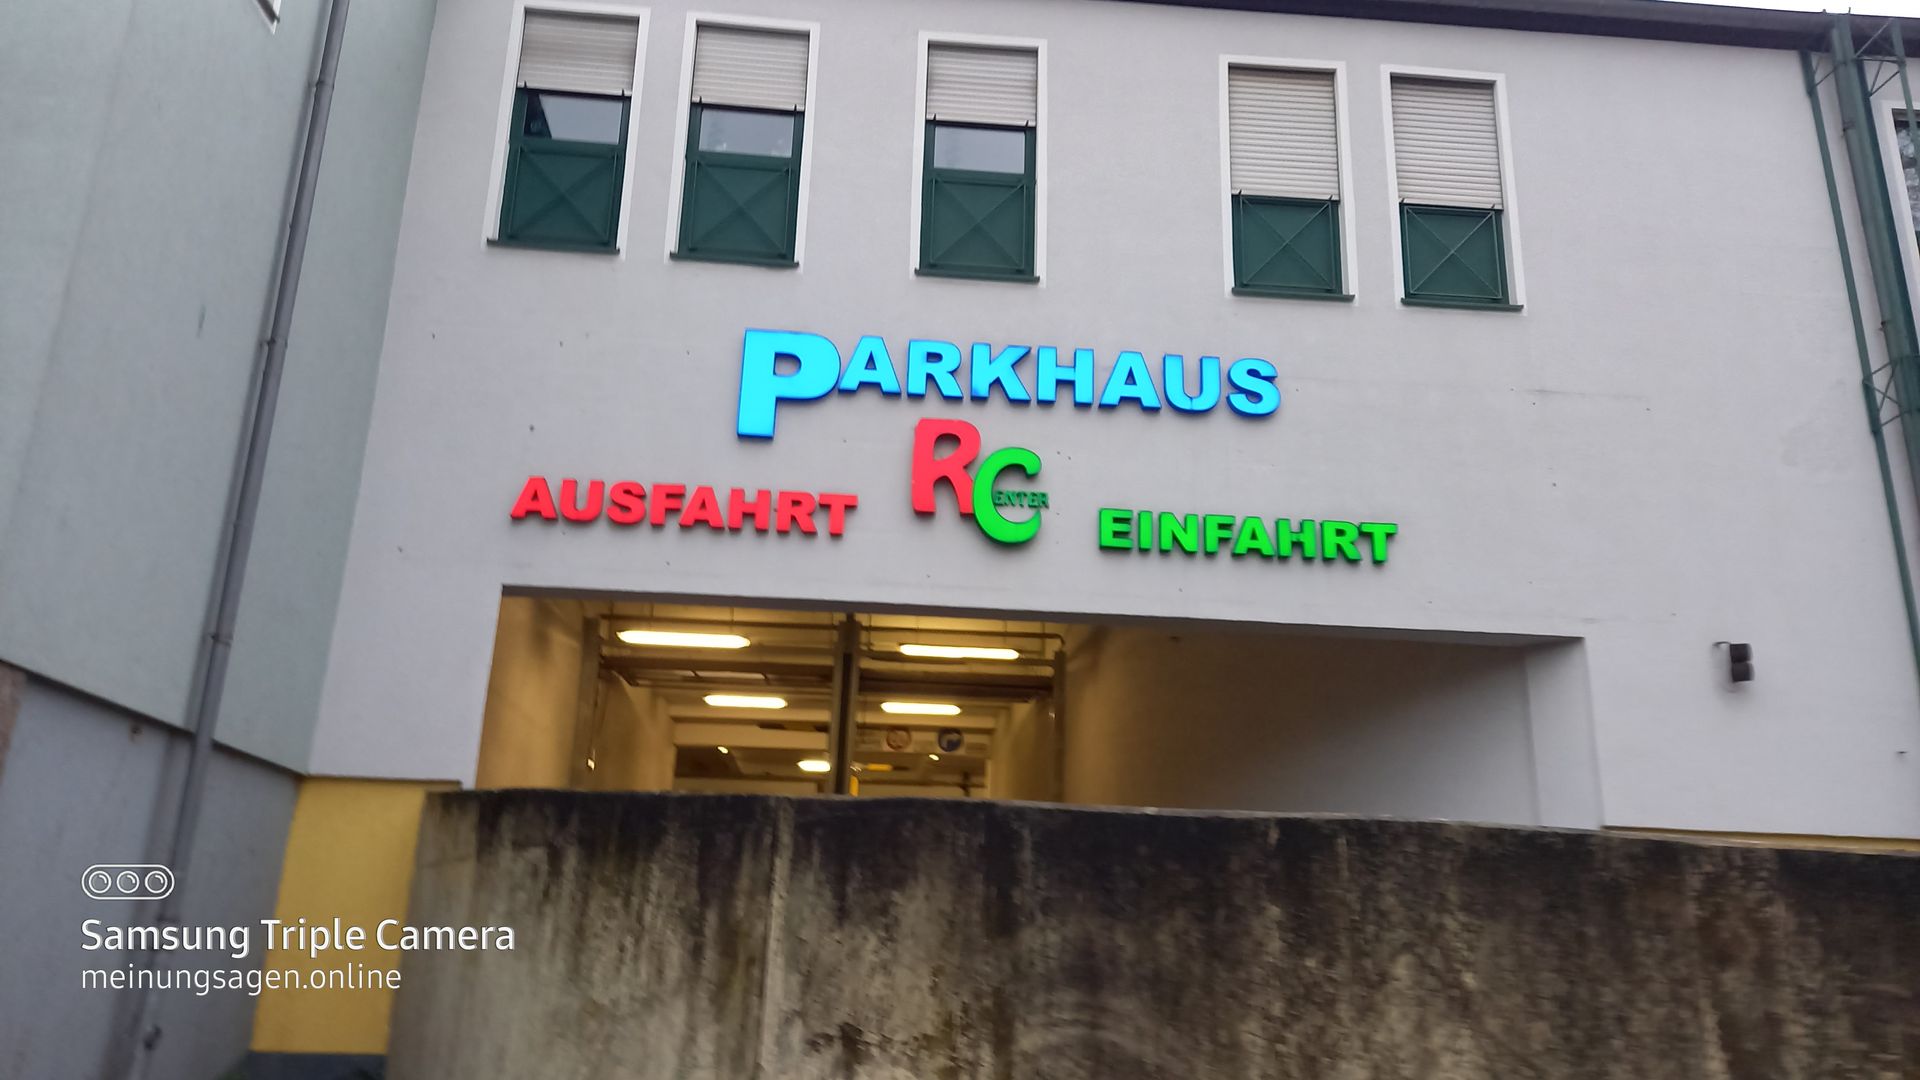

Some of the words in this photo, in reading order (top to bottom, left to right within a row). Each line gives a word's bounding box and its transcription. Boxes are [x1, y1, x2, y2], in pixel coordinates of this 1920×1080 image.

[736, 328, 1280, 439] PARKHAUS
[511, 476, 858, 537] AUSFAHRT
[1098, 508, 1398, 564] EINFAHRT
